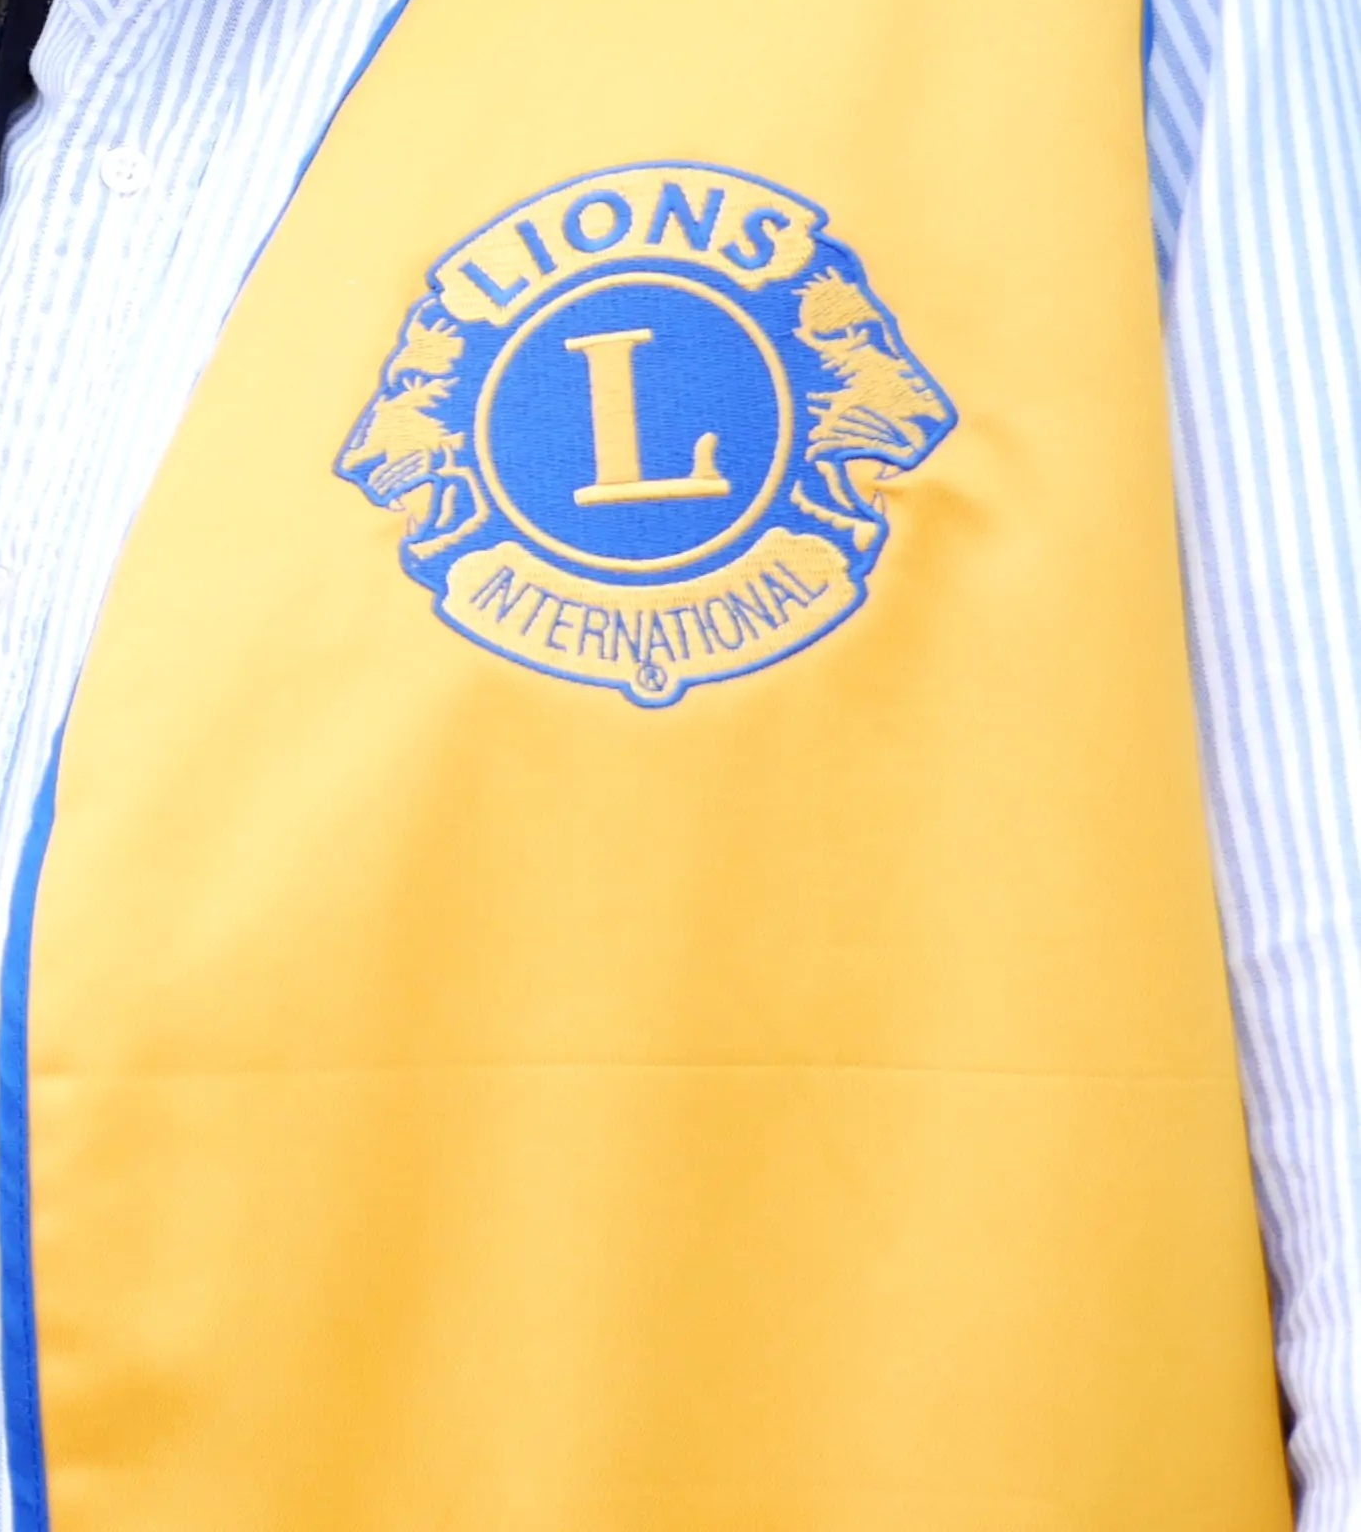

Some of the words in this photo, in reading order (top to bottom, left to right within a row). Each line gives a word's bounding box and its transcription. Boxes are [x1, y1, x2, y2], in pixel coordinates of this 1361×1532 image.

[458, 181, 791, 307] LIONS
[564, 328, 731, 505] L
[469, 560, 829, 664] INTERNATIONAL
